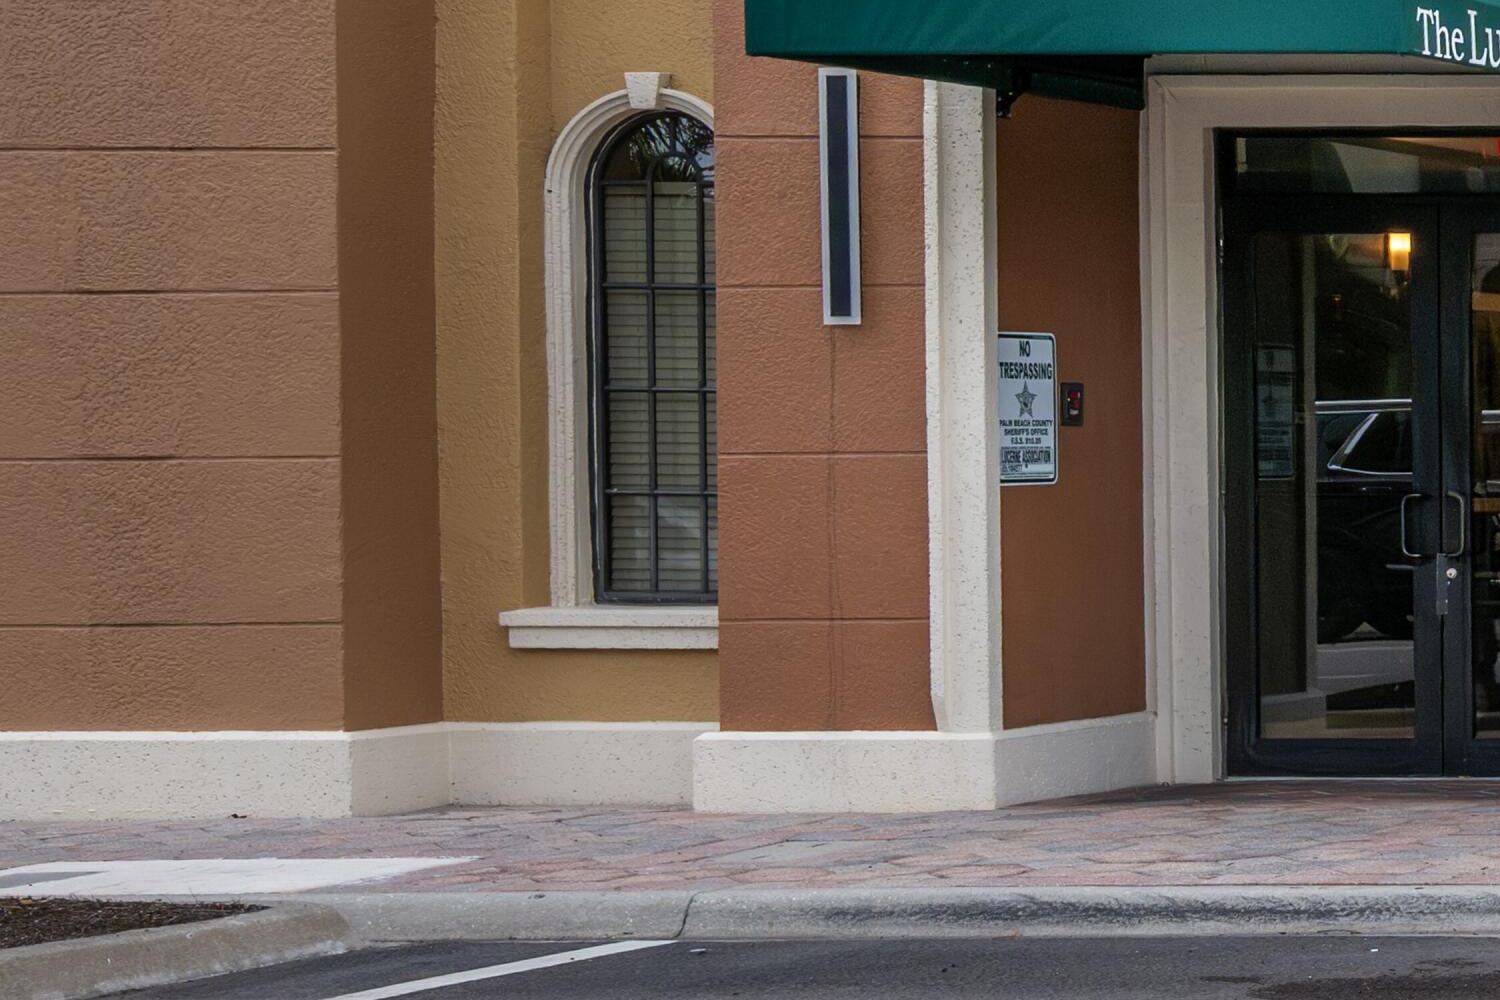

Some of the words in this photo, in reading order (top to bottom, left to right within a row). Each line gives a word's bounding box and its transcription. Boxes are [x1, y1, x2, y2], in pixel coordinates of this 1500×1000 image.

[1416, 6, 1465, 61] The
[1019, 340, 1031, 357] NO
[999, 361, 1053, 380] TRESPASSING
